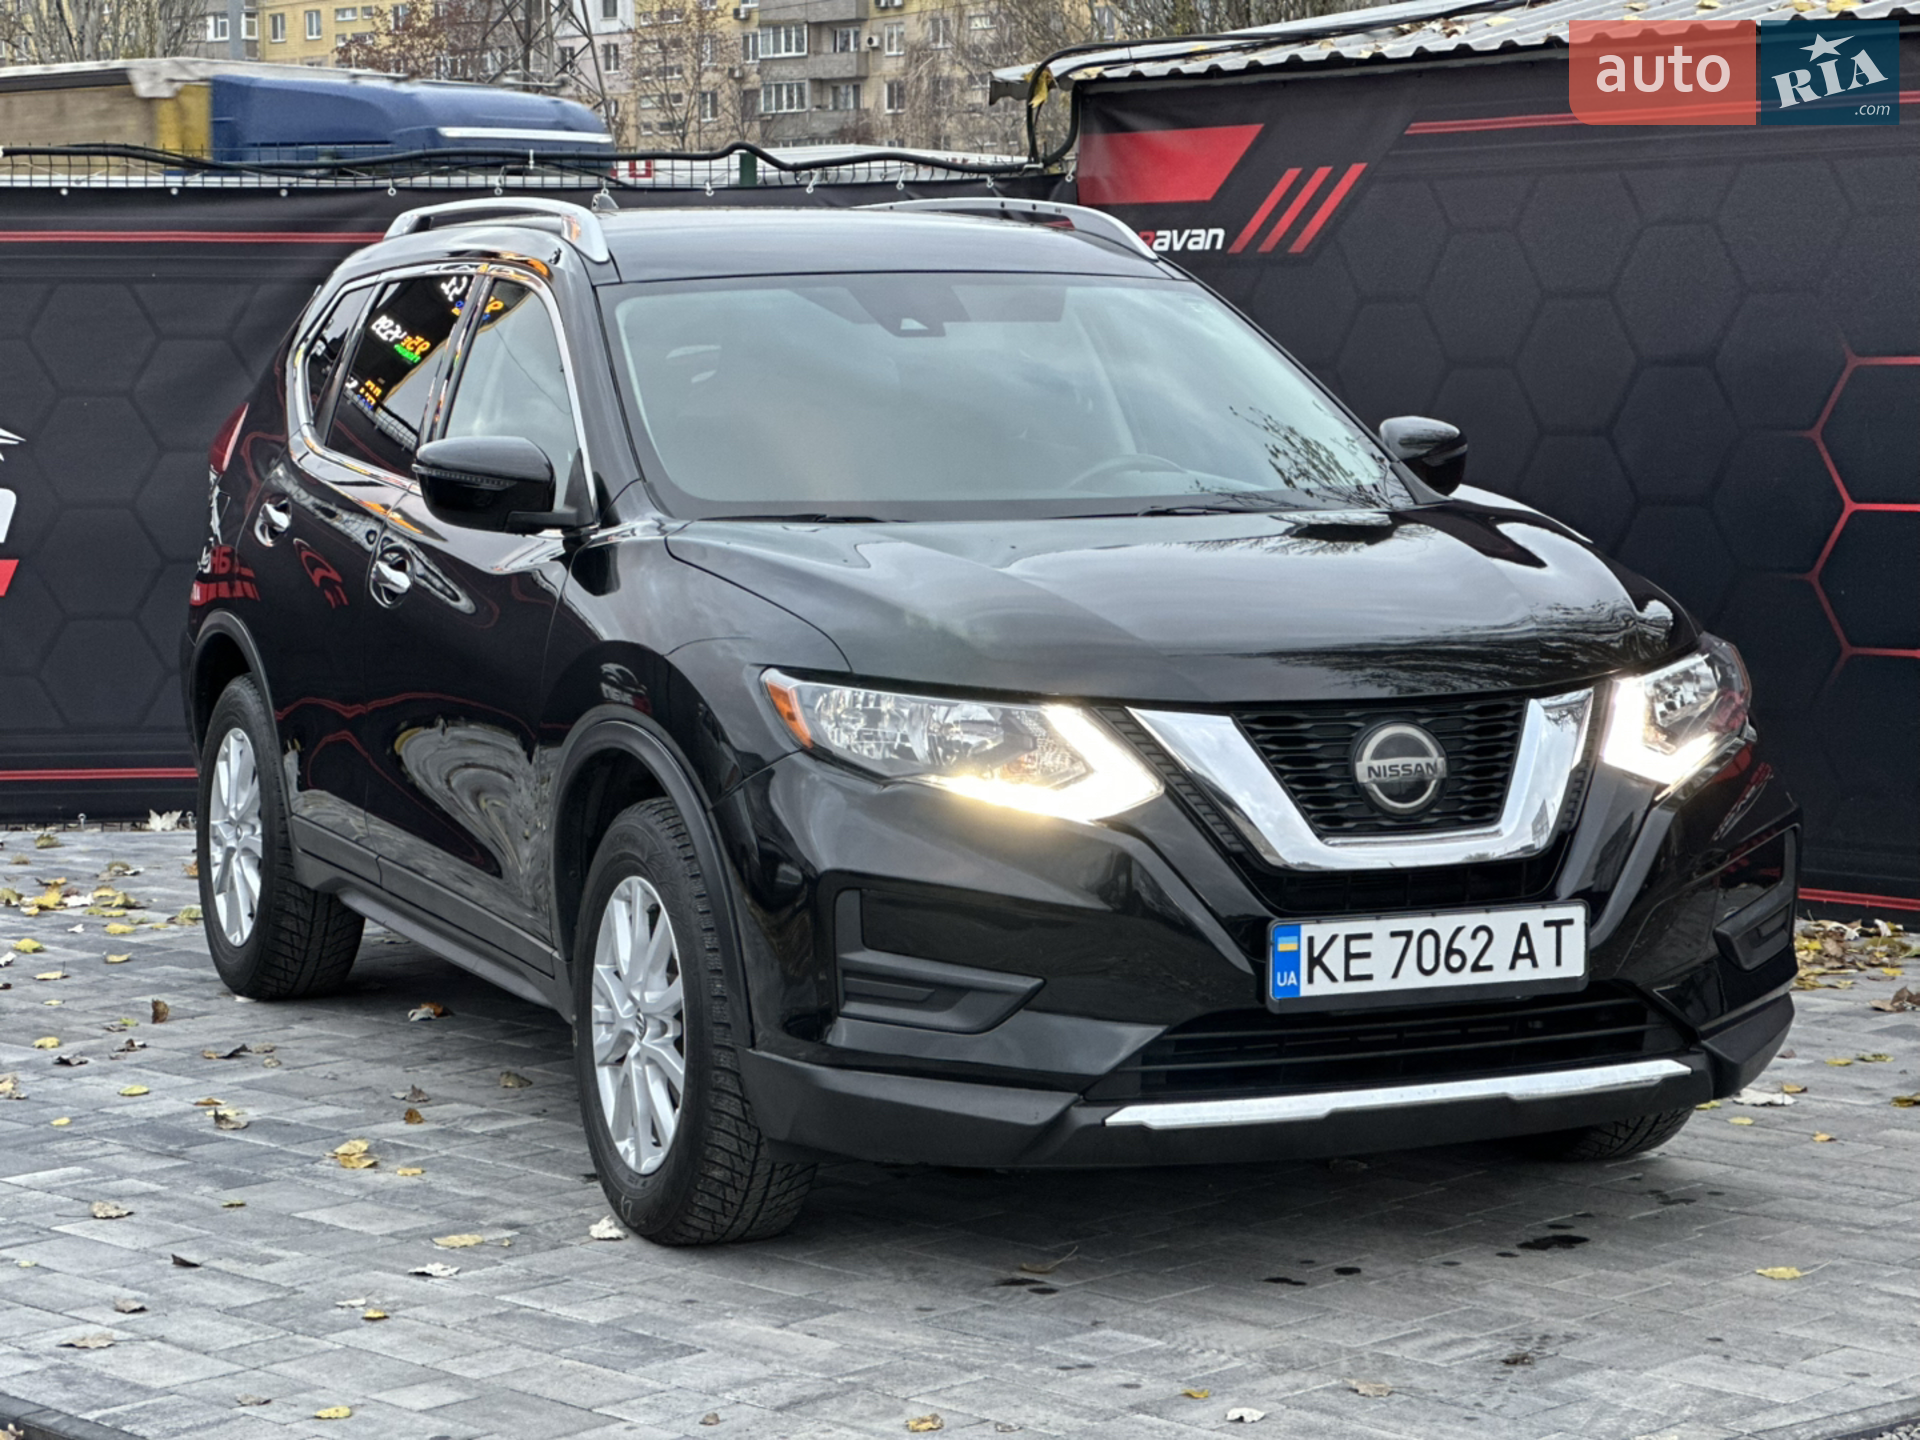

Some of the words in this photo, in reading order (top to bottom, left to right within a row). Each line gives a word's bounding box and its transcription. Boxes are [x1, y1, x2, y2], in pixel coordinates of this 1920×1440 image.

[1367, 762, 1437, 779] NISSAN
[1306, 932, 1374, 985] KE
[1390, 924, 1494, 980] 7062
[1508, 918, 1575, 971] AT
[1276, 970, 1298, 987] UA
